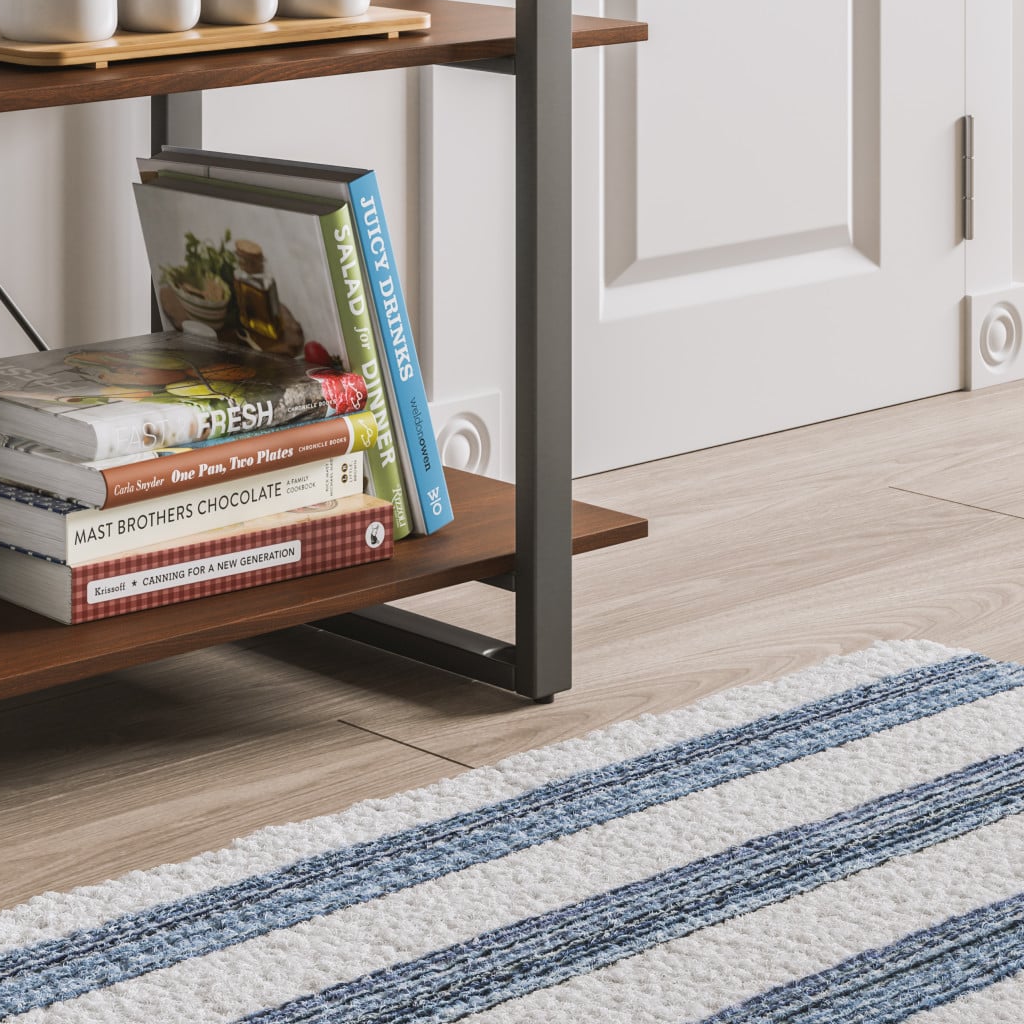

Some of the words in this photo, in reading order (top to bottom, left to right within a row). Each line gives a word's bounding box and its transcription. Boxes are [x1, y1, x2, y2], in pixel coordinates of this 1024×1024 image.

[334, 224, 365, 316] SALAD
[361, 195, 390, 272] JUICY
[379, 275, 414, 382] DRINKS
[353, 326, 371, 350] for
[196, 400, 273, 439] FRESH
[361, 358, 396, 468] DINNER
[409, 396, 431, 472] weldonowen
[114, 482, 135, 496] Carla
[136, 476, 165, 492] Snyder
[171, 469, 196, 483] One
[198, 463, 227, 478] Pan,
[229, 455, 254, 470] Two
[256, 447, 294, 464] Plates
[298, 441, 328, 452] CHRONICLE
[329, 436, 347, 446] BOOKS
[286, 482, 316, 494] COOKBOOK
[291, 476, 309, 484] FAMILY
[74, 522, 113, 545] MAST
[118, 503, 193, 535] BROTHERS
[197, 482, 282, 515] CHOCOLATE
[94, 583, 126, 597] Krissoff
[142, 570, 185, 587] CANNING
[187, 566, 206, 577] FOR
[207, 563, 215, 573] A
[217, 558, 238, 571] NEW
[240, 547, 296, 566] GENERATION
